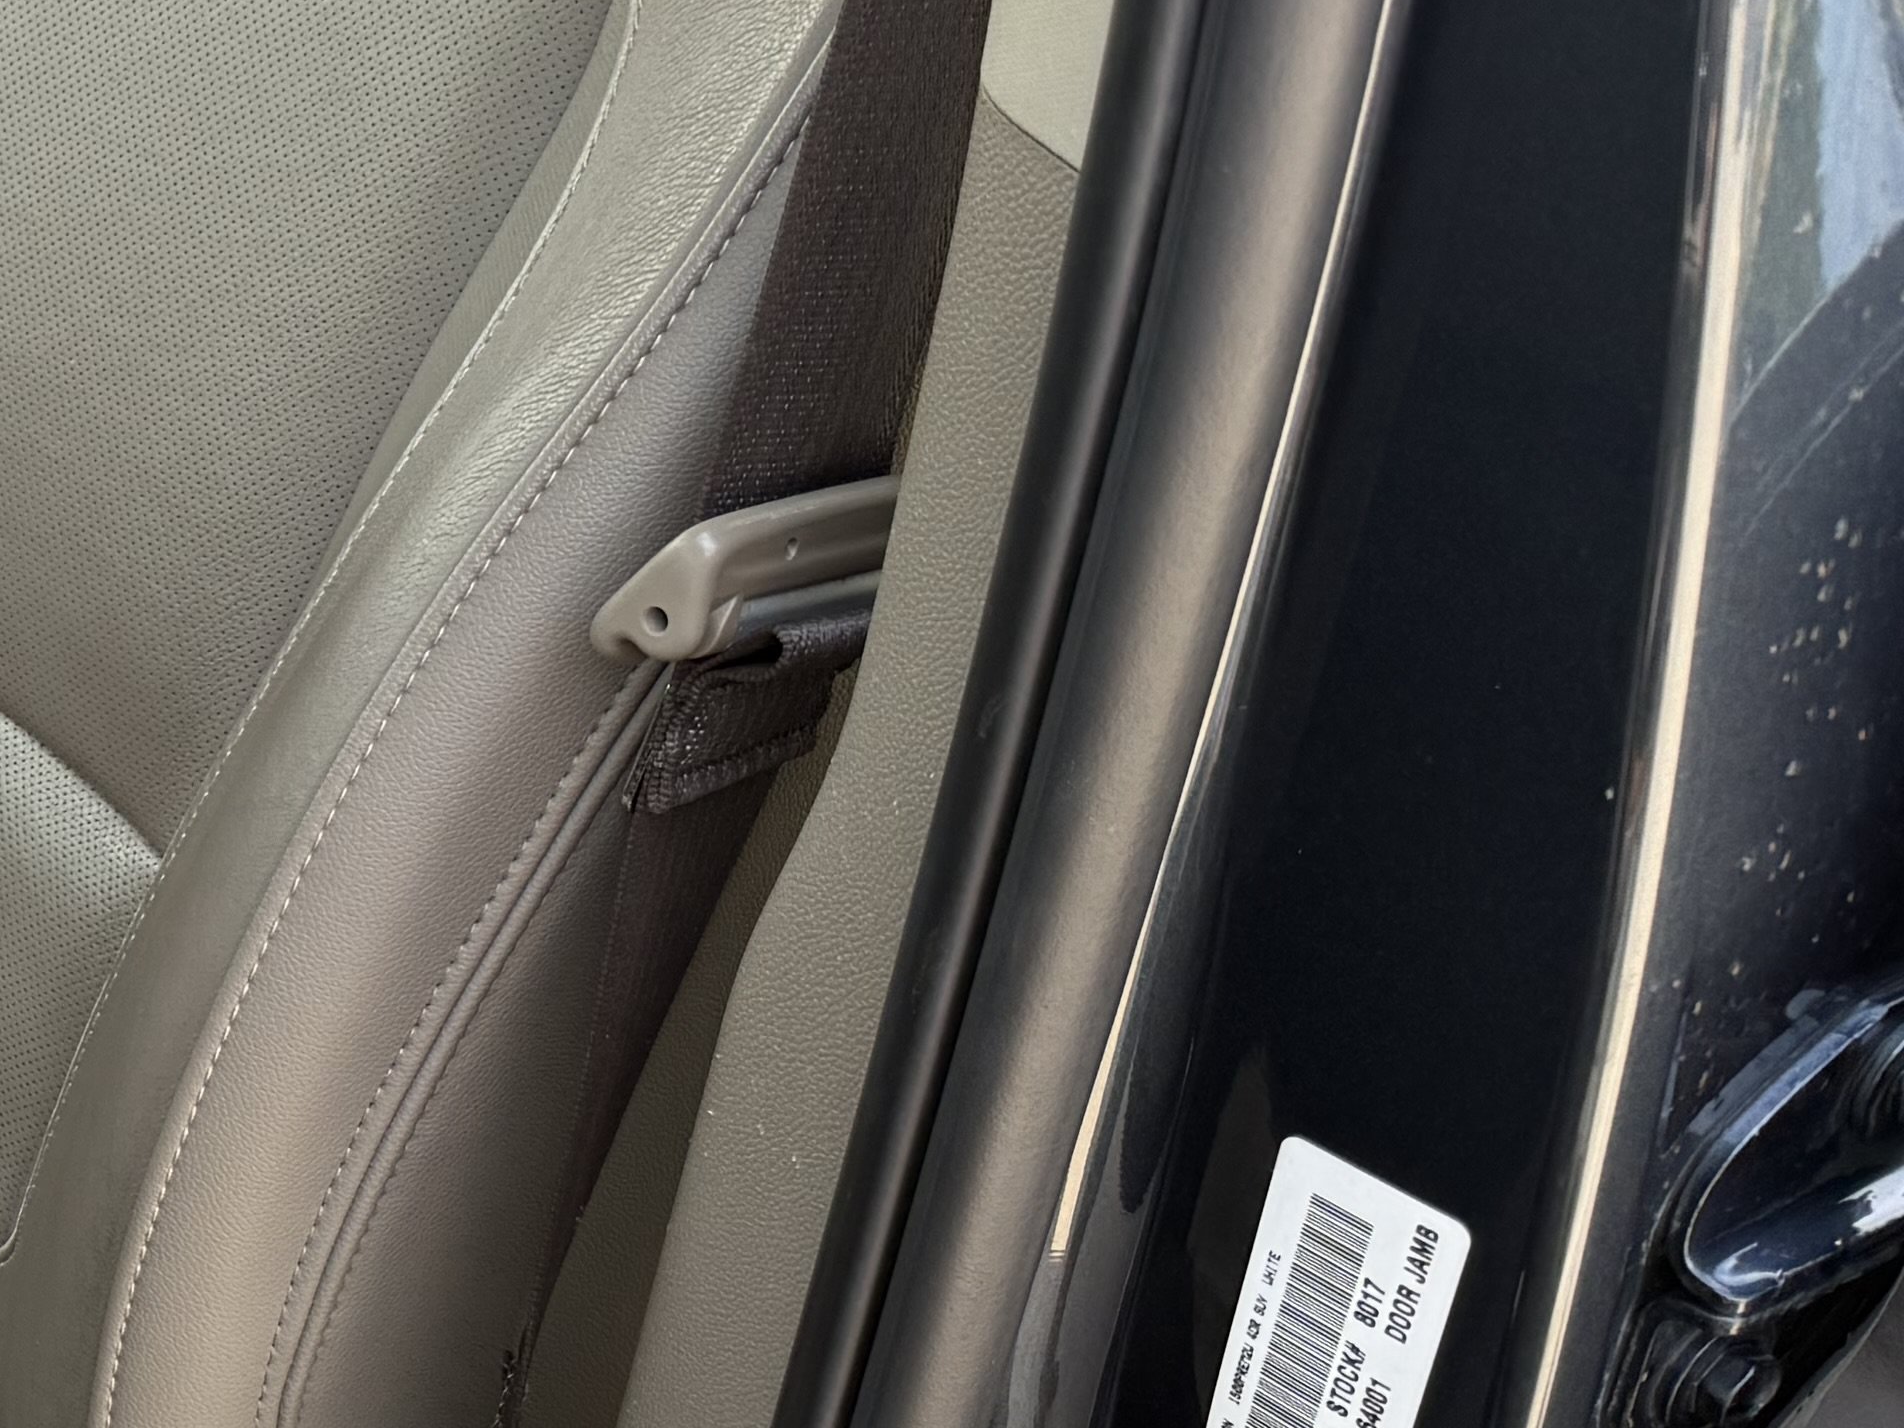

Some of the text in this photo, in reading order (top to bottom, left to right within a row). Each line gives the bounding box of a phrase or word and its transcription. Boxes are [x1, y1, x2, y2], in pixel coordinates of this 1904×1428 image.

[1252, 1294, 1268, 1317] SUV
[1263, 1249, 1282, 1286] WHITE
[1383, 1283, 1421, 1344] DOOR
[1403, 1224, 1439, 1284] JAMB
[1325, 1339, 1366, 1418] STOCK#
[1353, 1277, 1385, 1328] 8017
